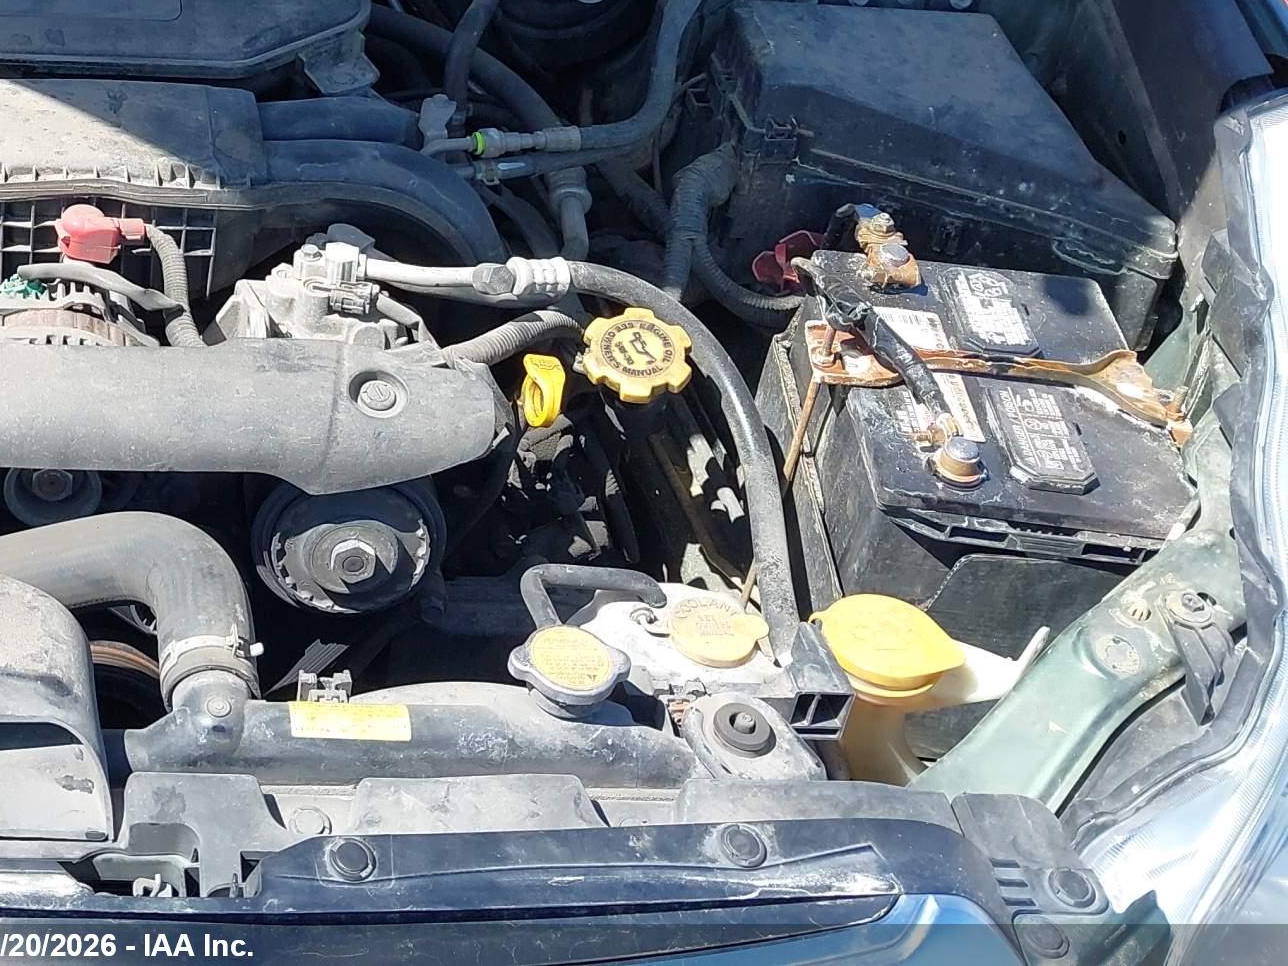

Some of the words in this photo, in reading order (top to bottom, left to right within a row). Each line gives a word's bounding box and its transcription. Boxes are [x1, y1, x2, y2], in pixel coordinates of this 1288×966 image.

[616, 322, 634, 332] SEE
[639, 323, 672, 349] ENGINE
[662, 349, 673, 363] OIL
[622, 365, 663, 377] MANUAL
